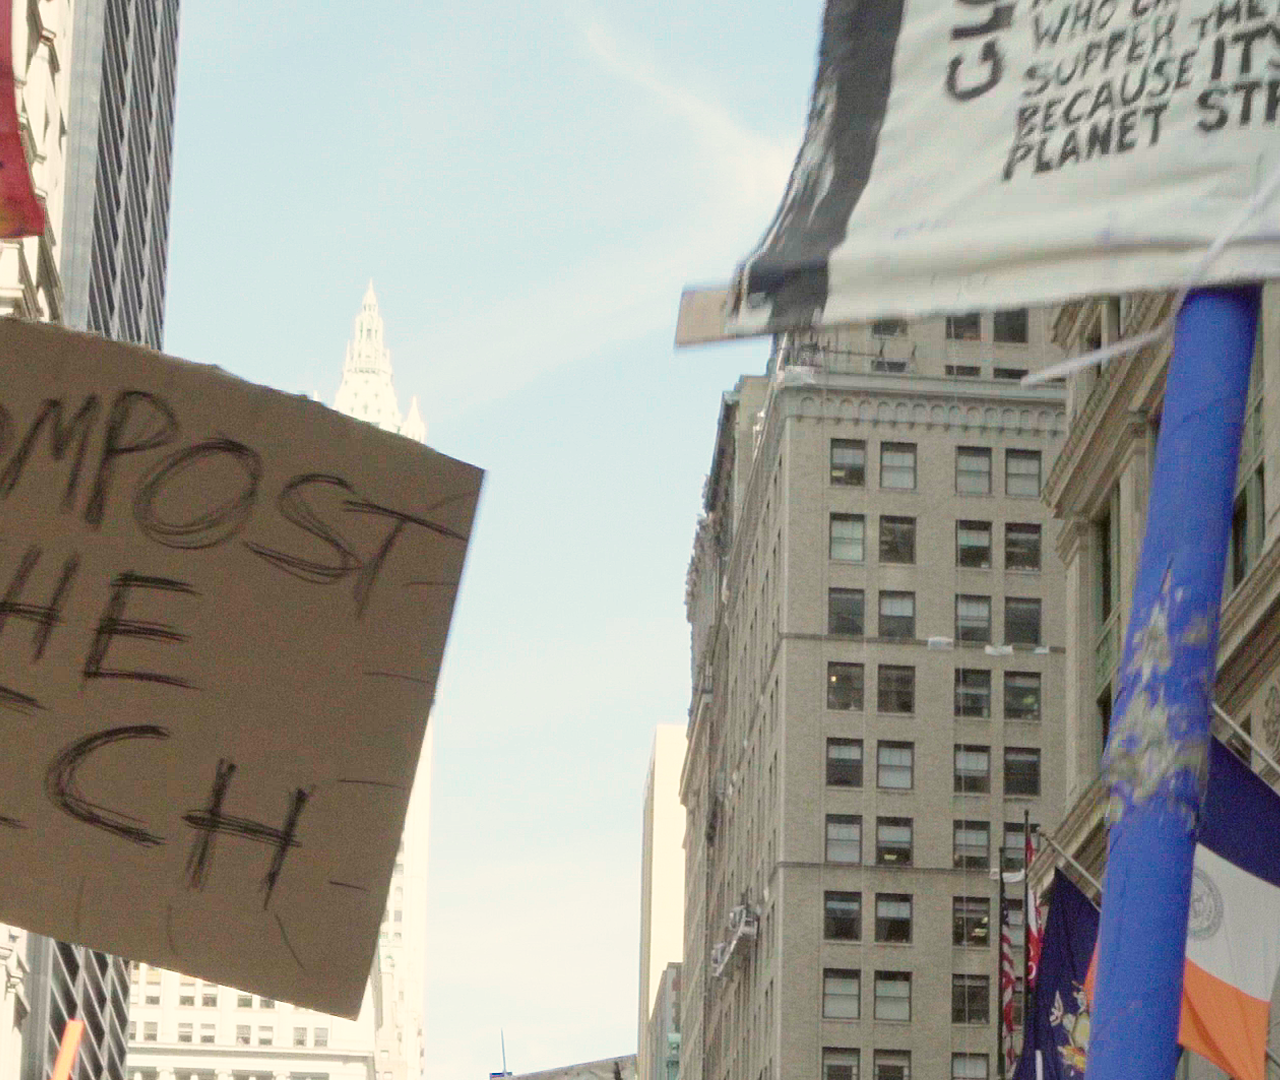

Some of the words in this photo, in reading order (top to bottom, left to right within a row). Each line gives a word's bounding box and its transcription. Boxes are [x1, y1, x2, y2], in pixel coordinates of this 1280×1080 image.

[946, 0, 1013, 103] GL
[1017, 49, 1198, 139] BECAUSE
[1023, 10, 1178, 97] SUFFER
[1002, 104, 1168, 181] PLANET
